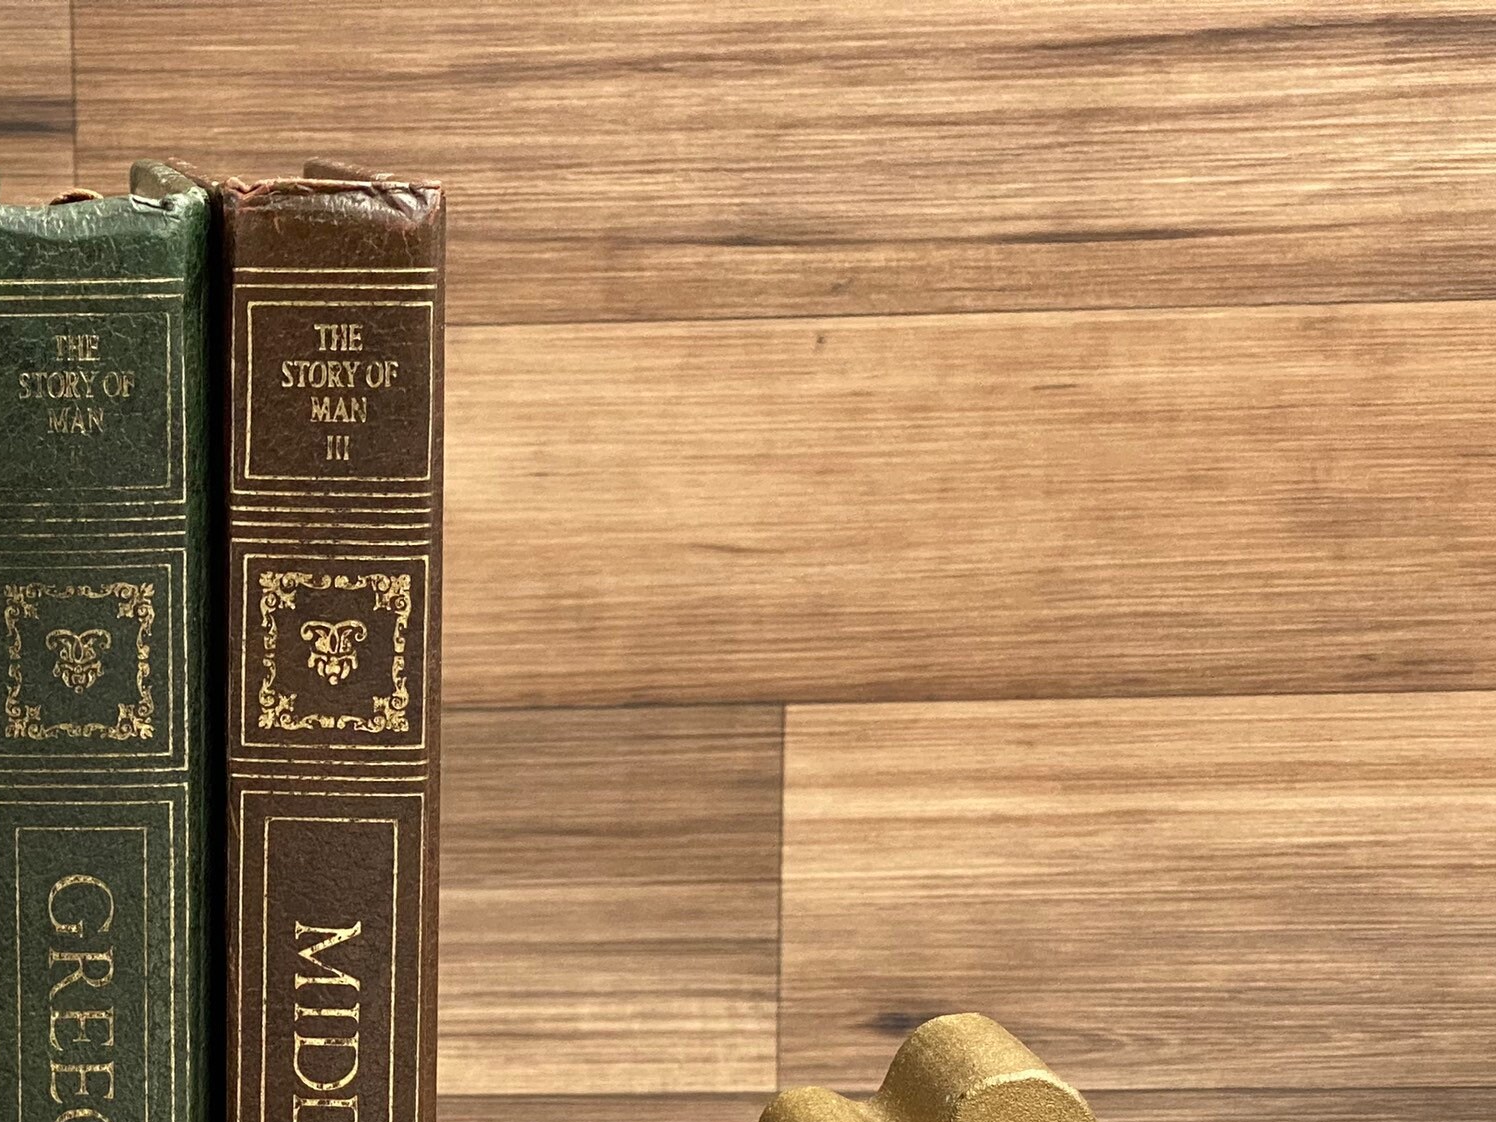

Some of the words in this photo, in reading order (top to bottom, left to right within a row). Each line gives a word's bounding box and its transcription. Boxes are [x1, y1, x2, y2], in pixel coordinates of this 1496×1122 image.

[54, 334, 101, 361] THE
[313, 323, 364, 351] THE
[18, 370, 100, 399] STORY
[103, 371, 136, 398] OF
[281, 360, 361, 388] STORY
[365, 360, 399, 388] OF
[47, 407, 104, 433] MAN
[310, 396, 367, 423] MAN
[325, 435, 350, 461] III
